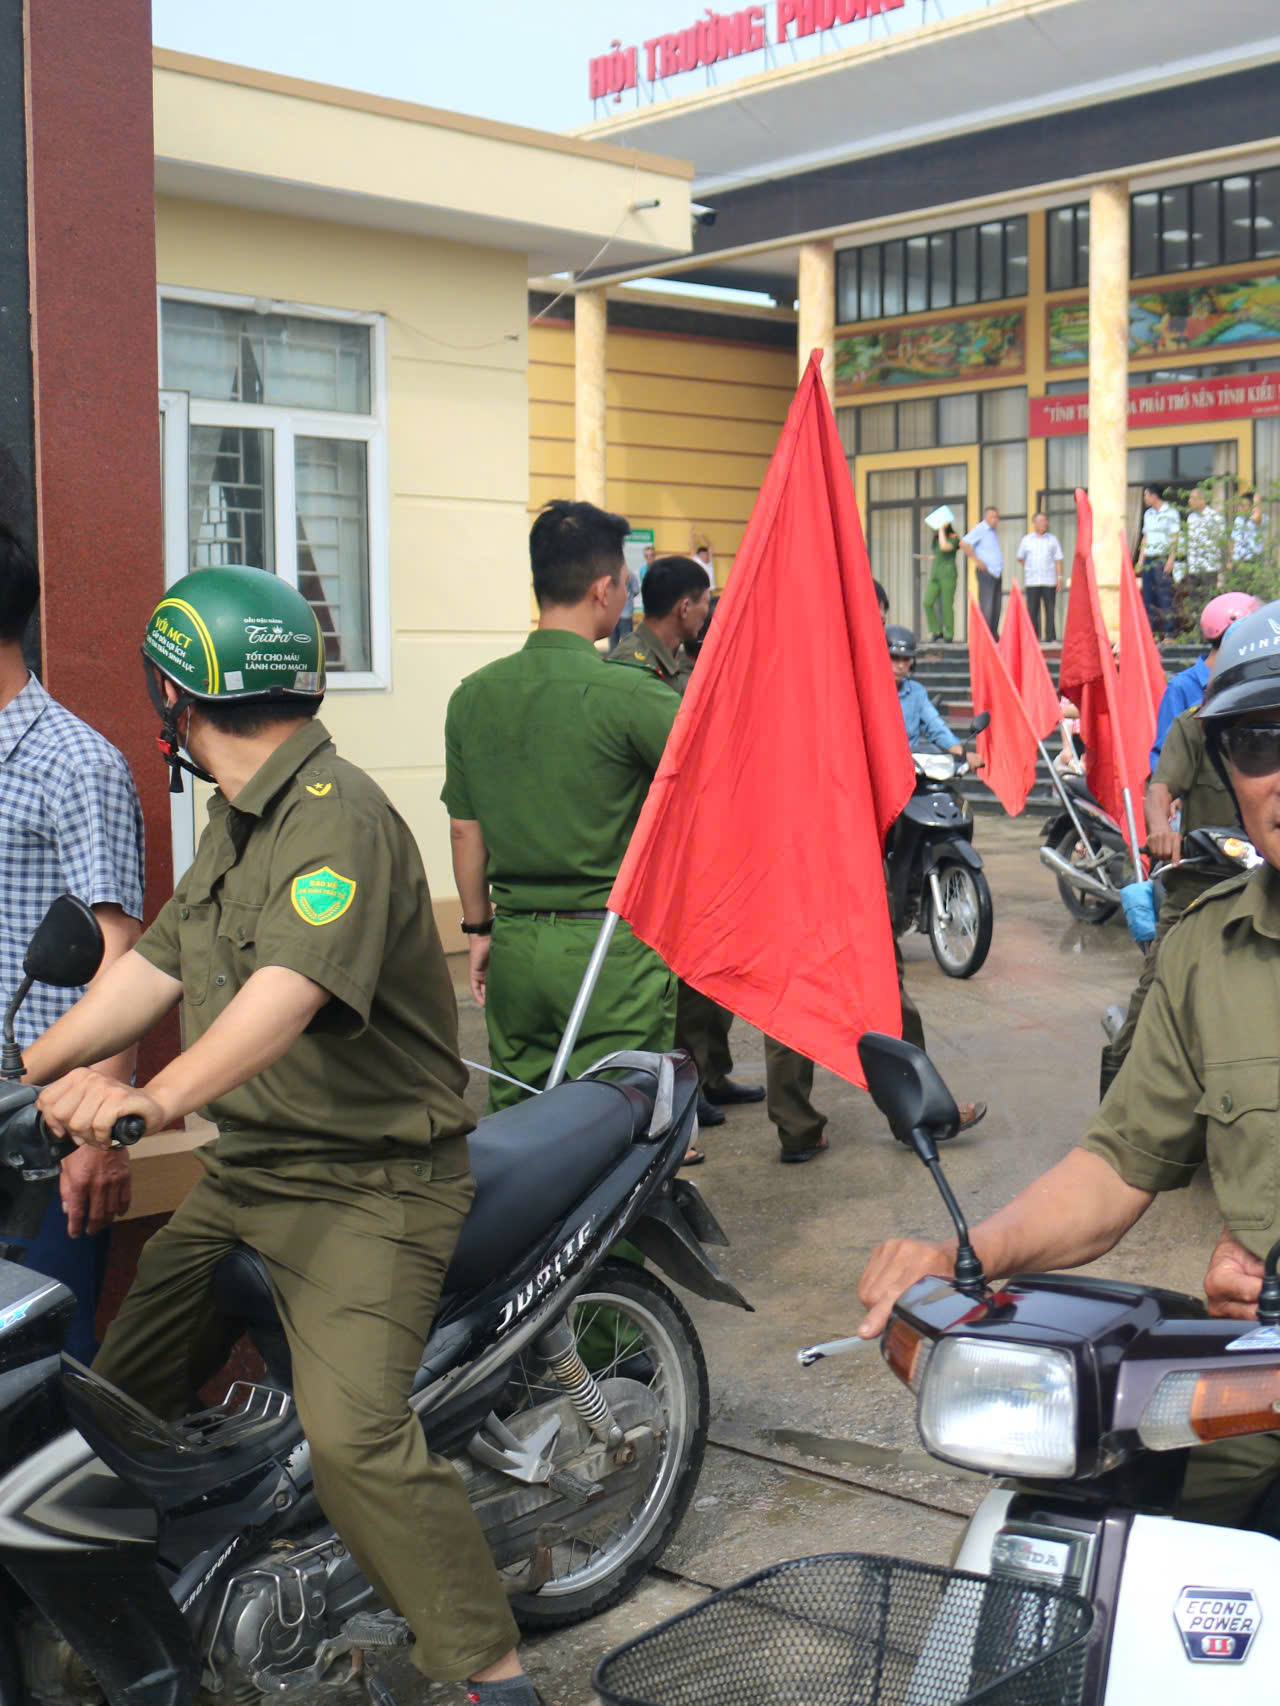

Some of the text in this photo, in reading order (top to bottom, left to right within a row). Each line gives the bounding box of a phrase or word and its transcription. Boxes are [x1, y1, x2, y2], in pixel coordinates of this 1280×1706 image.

[643, 6, 765, 81] TRƯỜNG
[167, 627, 192, 648] MCT
[244, 625, 291, 644] Tiara
[245, 651, 300, 661] TỐT CHO MÁU
[245, 661, 308, 672] LÀNH CHO MẠCH
[180, 1537, 239, 1614] ERO SPORT
[1186, 1601, 1248, 1616] ECONO
[1189, 1616, 1254, 1632] POWER
